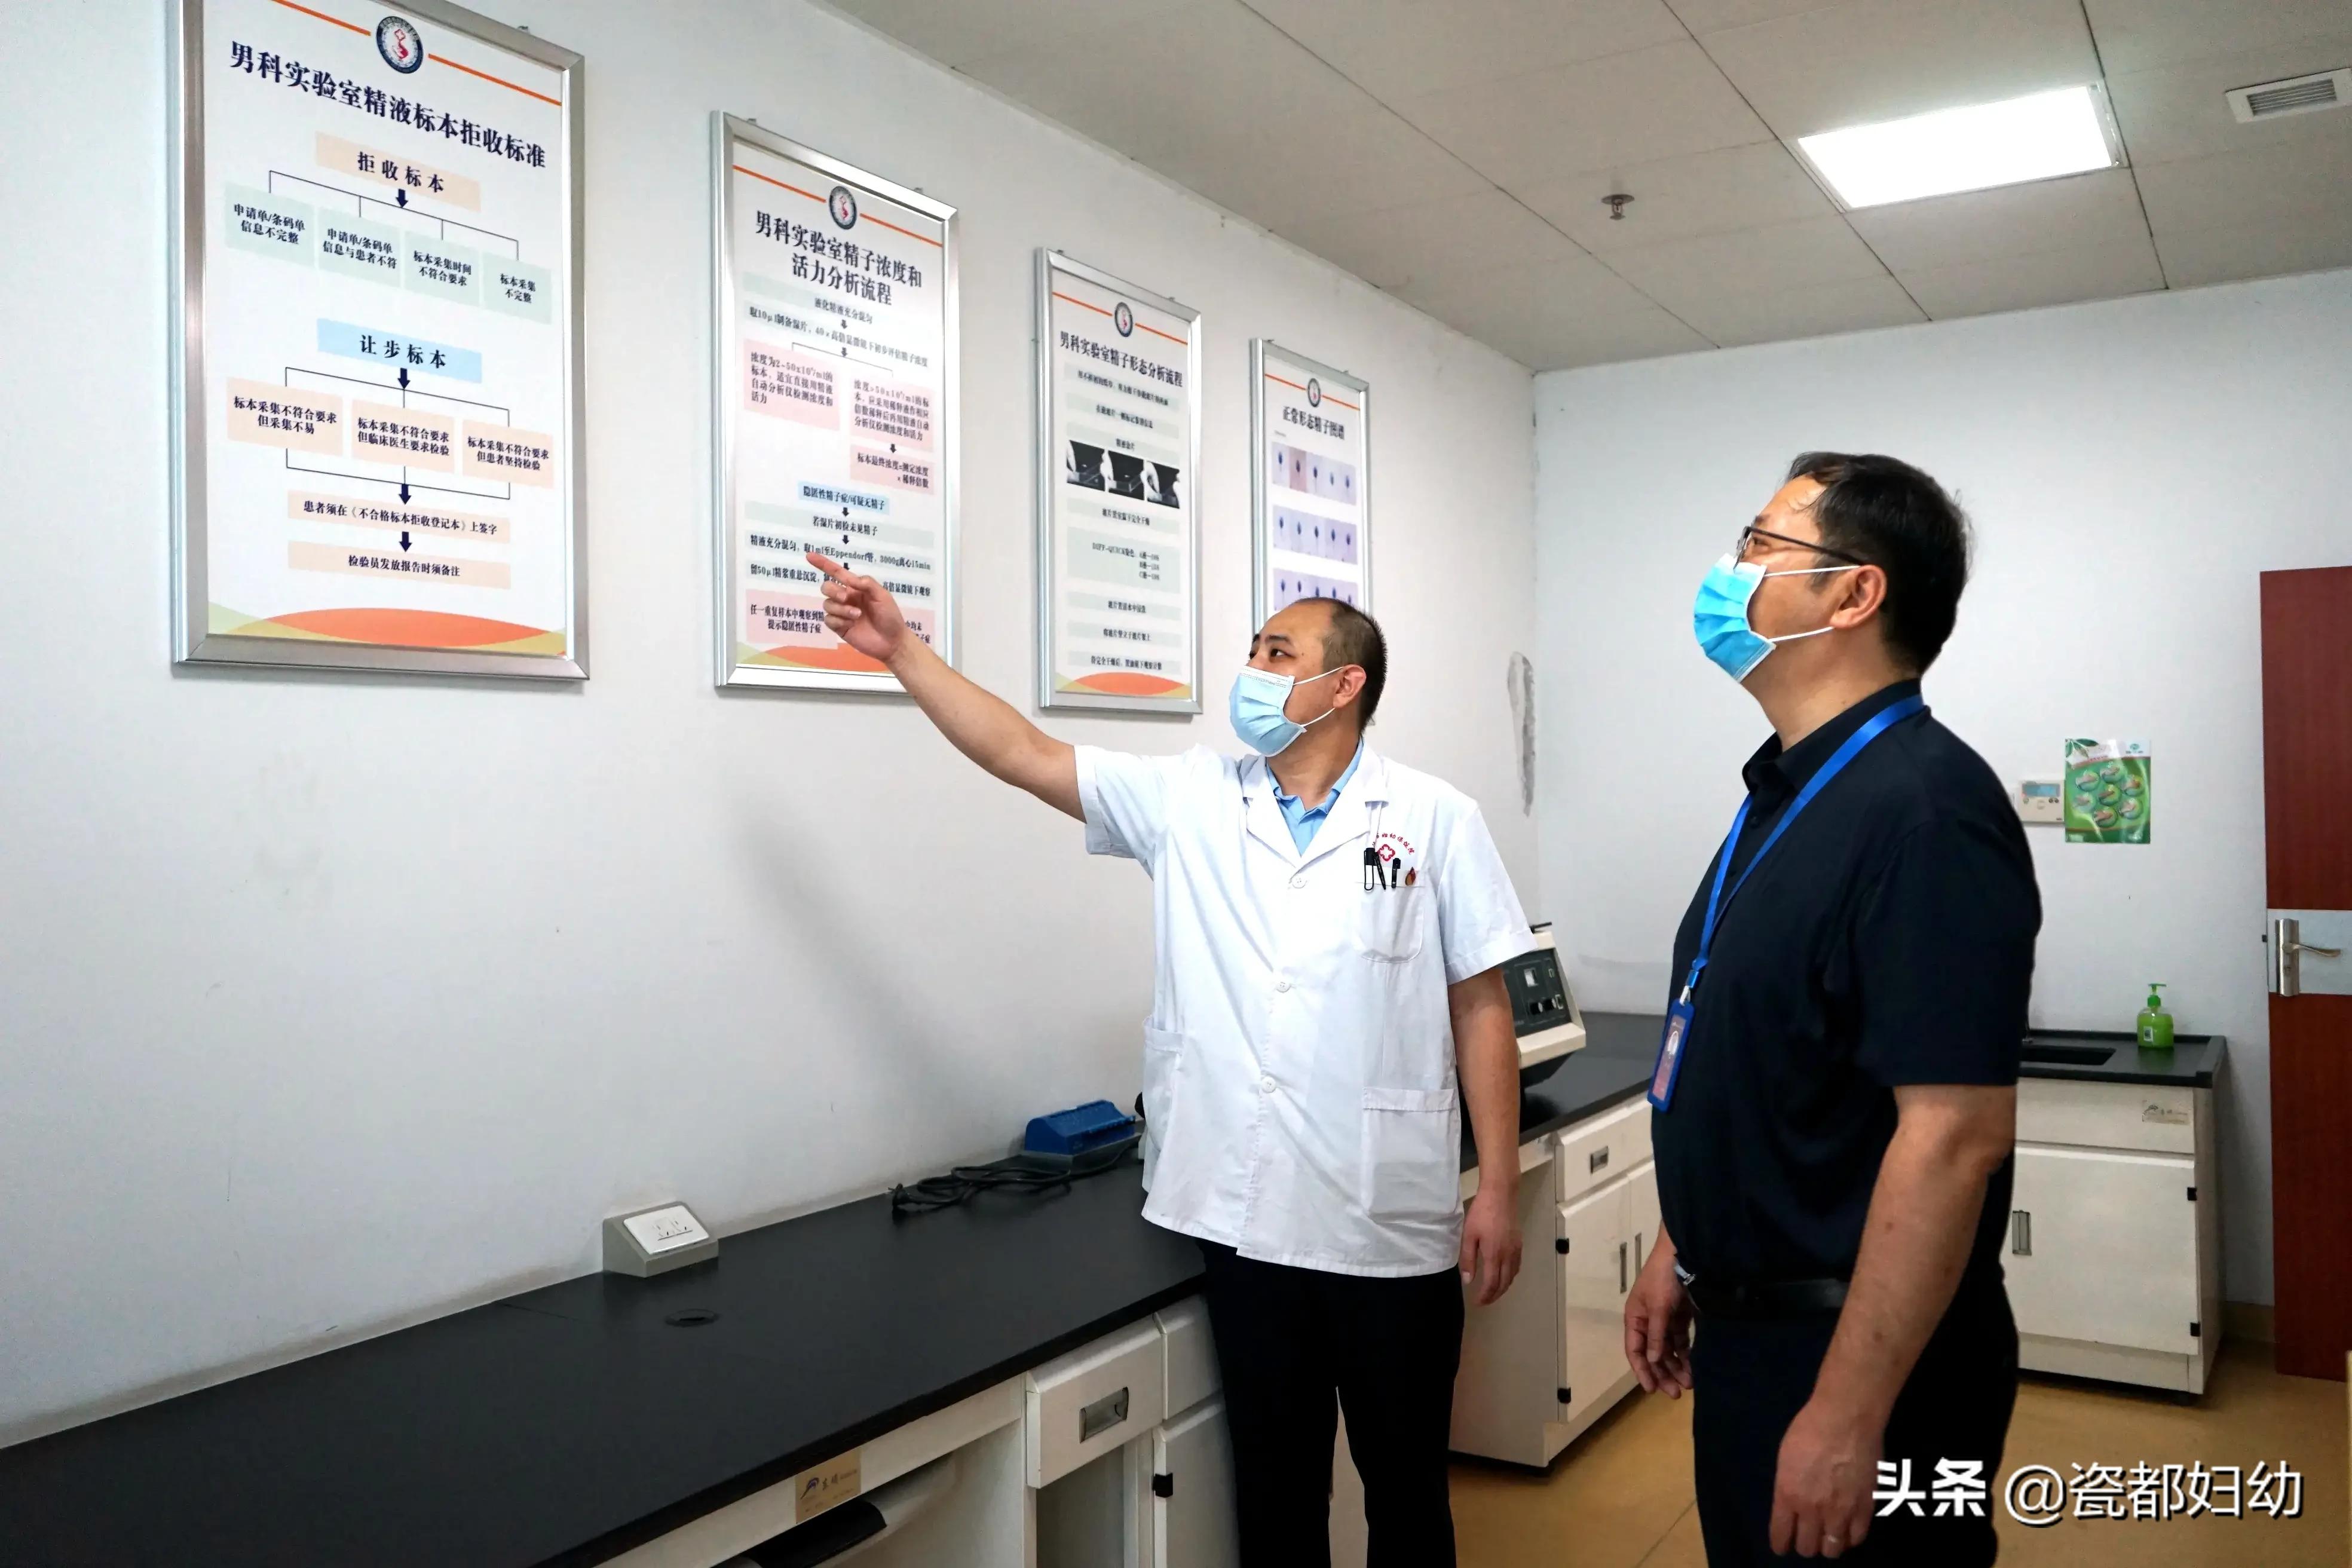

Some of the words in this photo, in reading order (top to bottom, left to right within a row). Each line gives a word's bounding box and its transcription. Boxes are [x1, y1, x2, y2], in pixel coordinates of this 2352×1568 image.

[231, 40, 547, 169] 男科实验室精液标本拒收标准
[357, 151, 444, 193] 拒收标本
[234, 203, 306, 232] 申请单/条码单
[241, 219, 299, 245] 信息不完整
[327, 227, 393, 255] 申请单/条码单
[323, 240, 397, 270] 信息与患者不符
[756, 210, 923, 288] 男科实验室精子浓度和
[414, 250, 472, 276] 标本采集时间
[419, 266, 467, 287] 不符合要求
[500, 272, 536, 292] 标本采集
[792, 252, 892, 306] 活力分析流程
[504, 289, 532, 304] 不完整
[359, 334, 447, 369] 让步标本
[1059, 330, 1184, 388] 男科实验室精子形态分析流程
[234, 396, 337, 425] 标本采集不符合要求
[751, 390, 767, 405] 活力
[258, 414, 315, 435] 但采集不易
[357, 417, 449, 443] 标本采集不符合要求
[357, 431, 450, 457] 但临床医生要求检验
[467, 436, 550, 460] 标本采集不符合要求
[477, 451, 541, 471] 但患者坚持检验
[304, 500, 498, 536] 患者须在《不合格标本拒收登记本》上签字
[348, 555, 461, 578] 检验员发放报告时须备注
